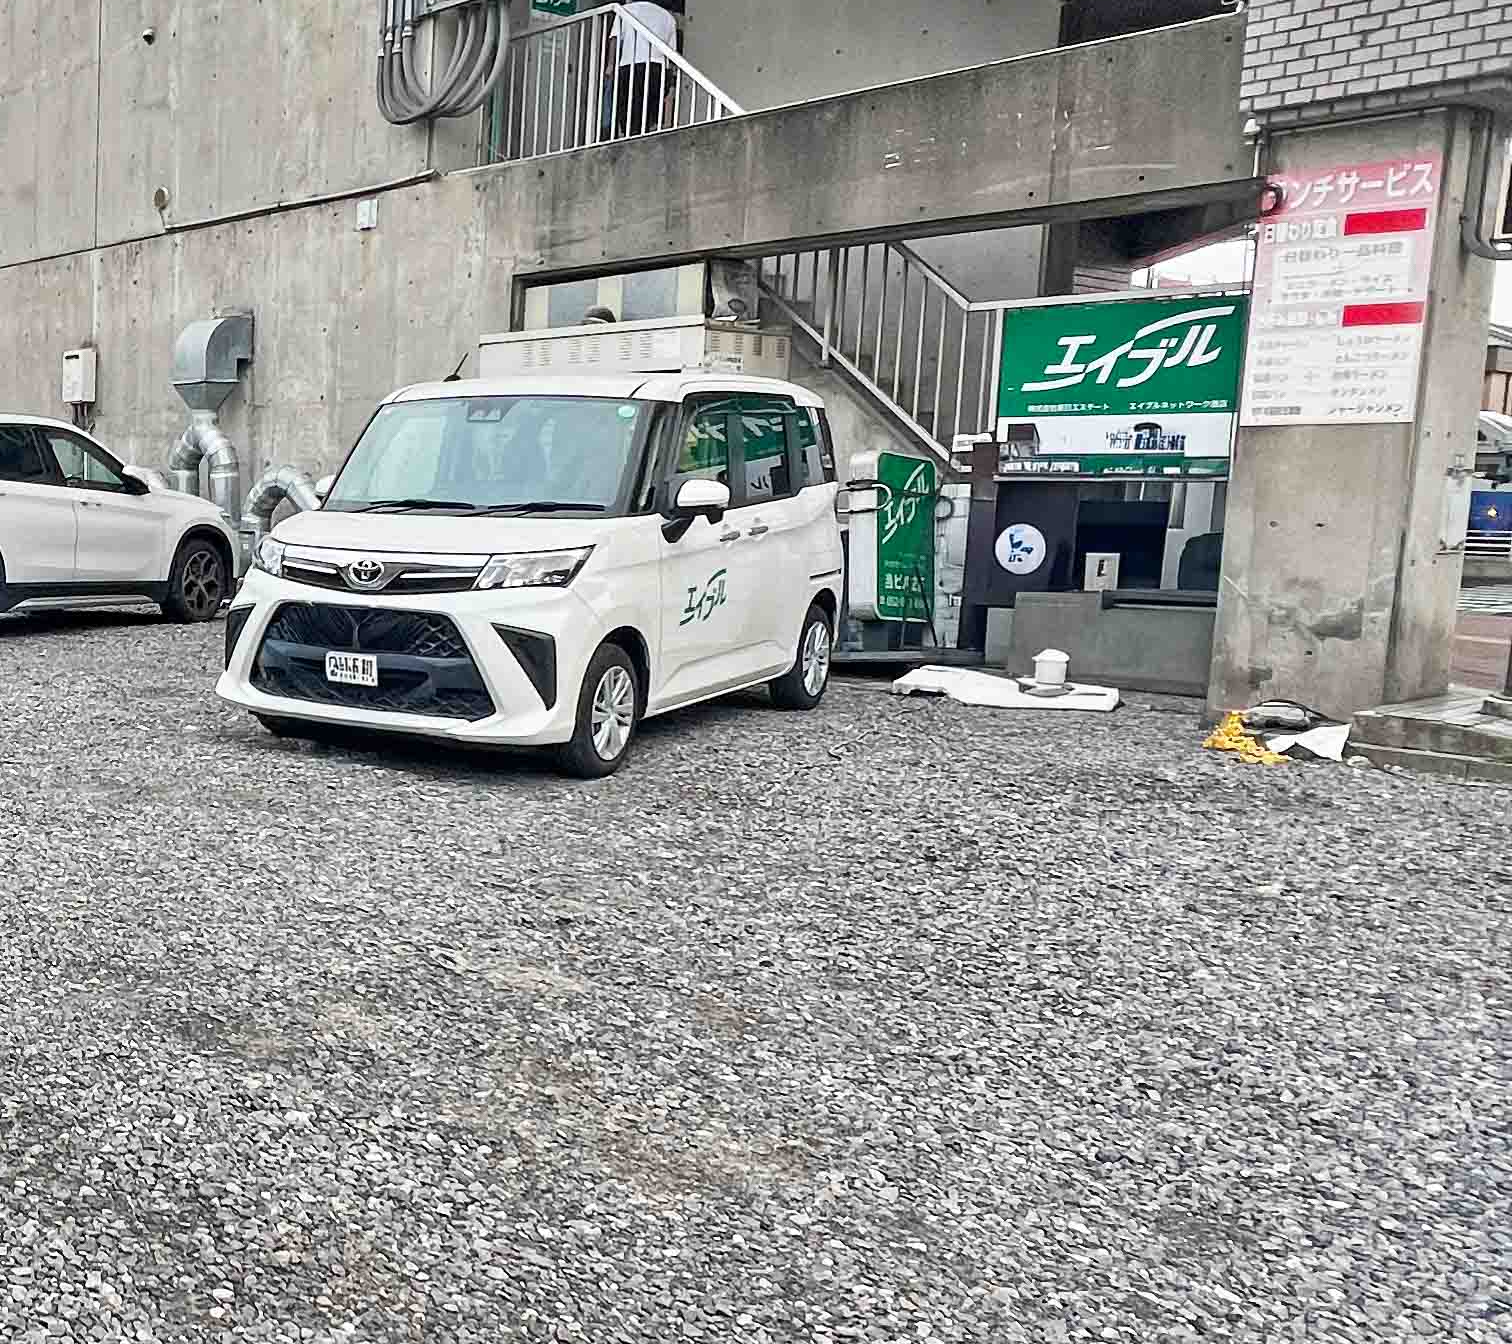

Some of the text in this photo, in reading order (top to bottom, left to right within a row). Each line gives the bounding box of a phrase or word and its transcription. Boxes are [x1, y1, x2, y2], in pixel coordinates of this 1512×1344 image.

[1020, 305, 1236, 392] エイブル
[882, 462, 930, 545] エイブル
[679, 567, 728, 626] エイブル
